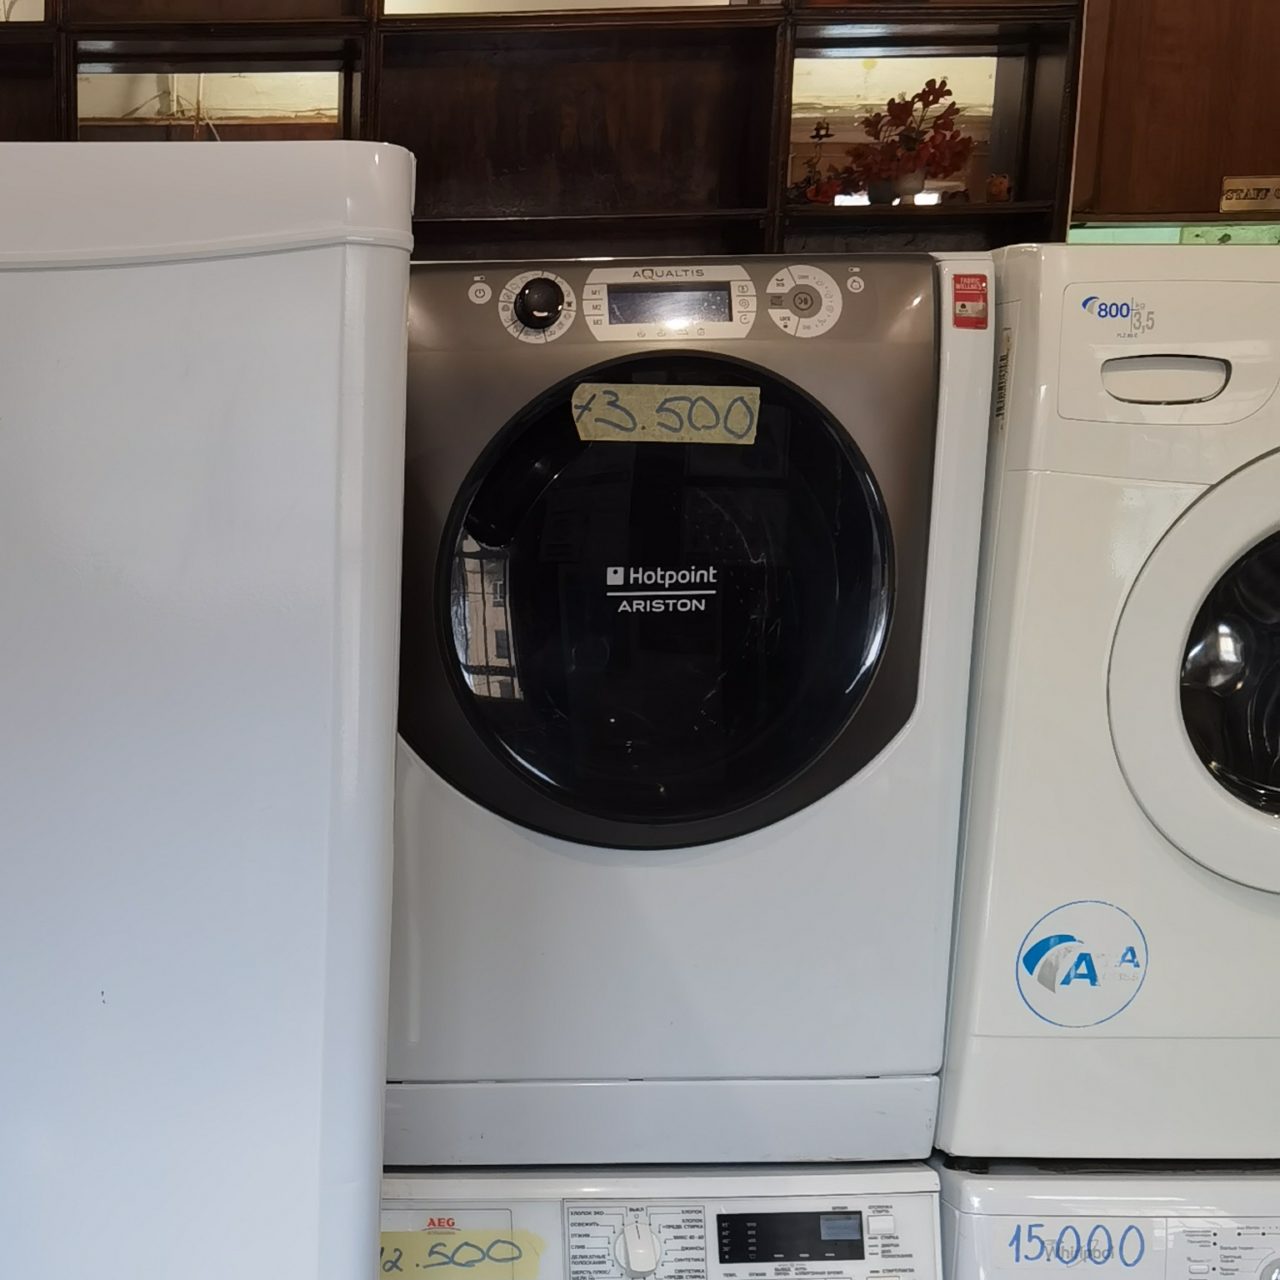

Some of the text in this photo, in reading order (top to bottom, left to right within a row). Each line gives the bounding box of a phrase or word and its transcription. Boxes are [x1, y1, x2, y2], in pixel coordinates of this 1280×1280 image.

[632, 269, 705, 280] AQUALTIS
[1097, 302, 1130, 318] 800
[1133, 311, 1155, 334] 3,5
[630, 565, 718, 588] Hotpoint
[617, 599, 706, 612] ARISTON
[427, 1217, 456, 1227] AEG
